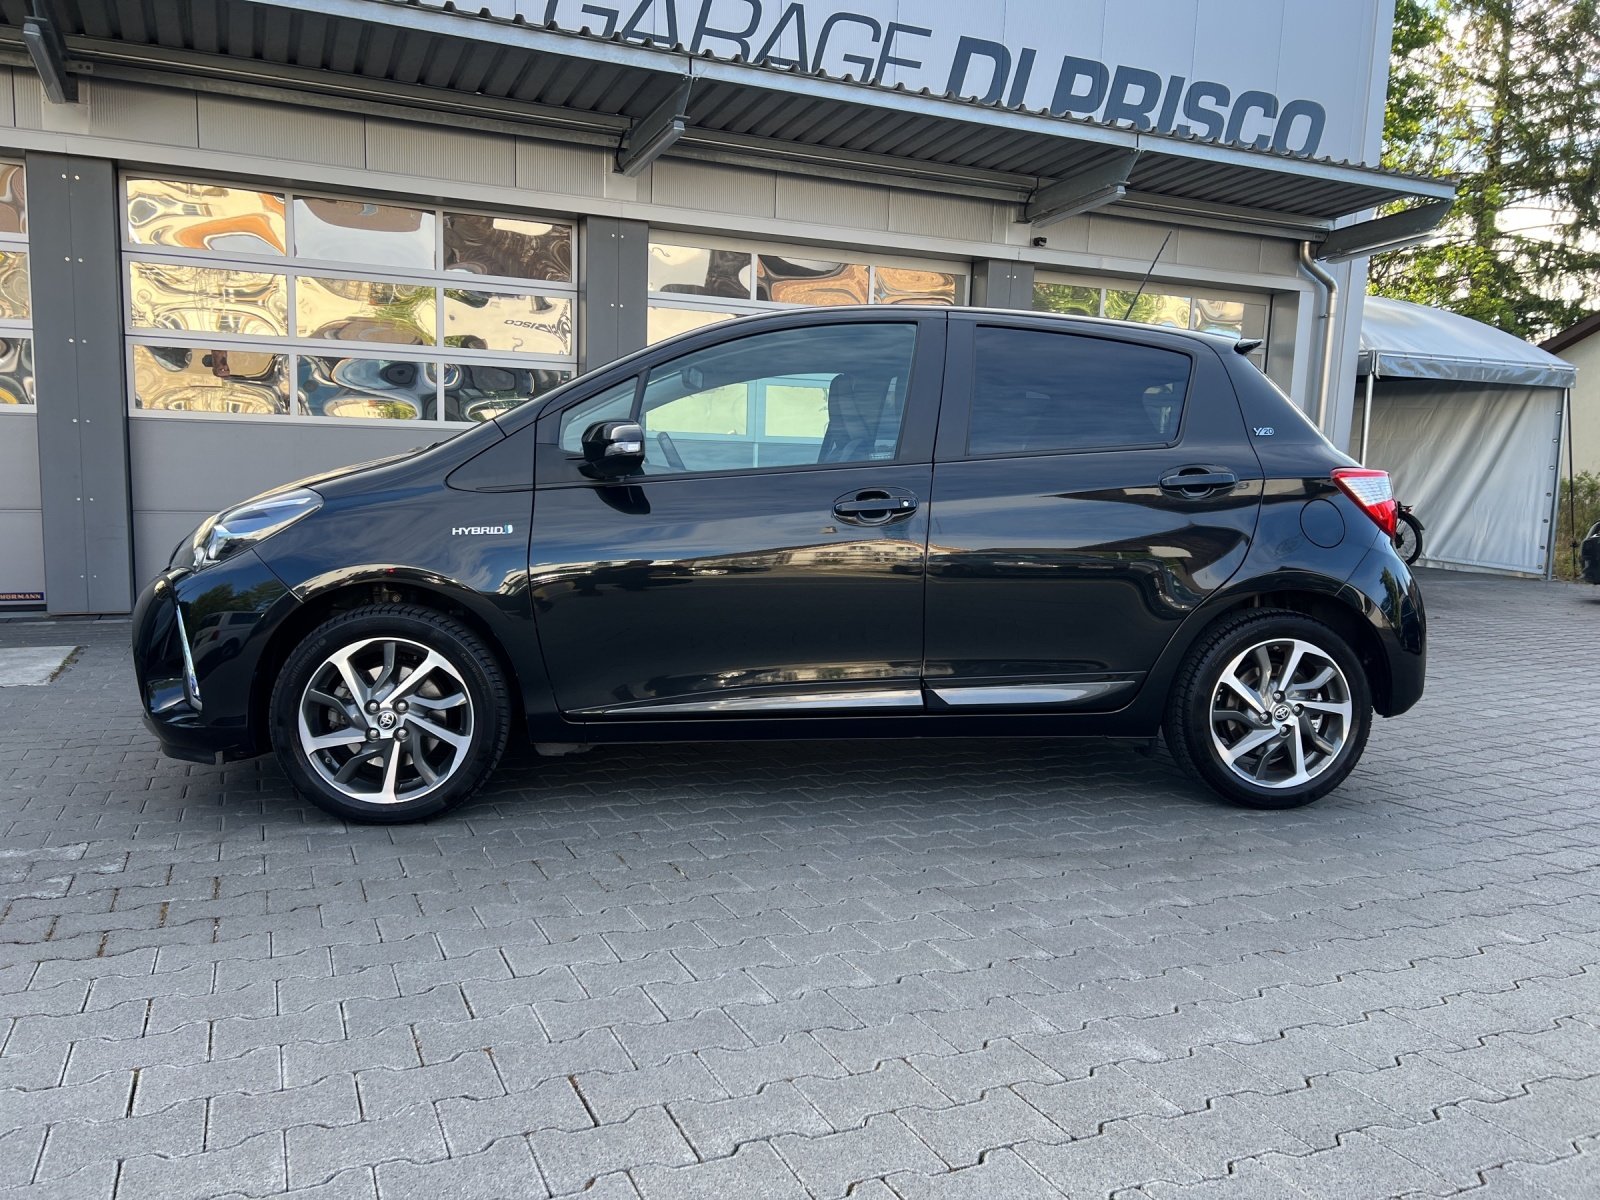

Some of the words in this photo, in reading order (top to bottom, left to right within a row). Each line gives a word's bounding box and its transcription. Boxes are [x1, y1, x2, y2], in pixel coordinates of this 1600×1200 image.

[944, 35, 1037, 107] DI
[1050, 55, 1327, 157] PRISCO
[452, 526, 504, 536] HYBRID
